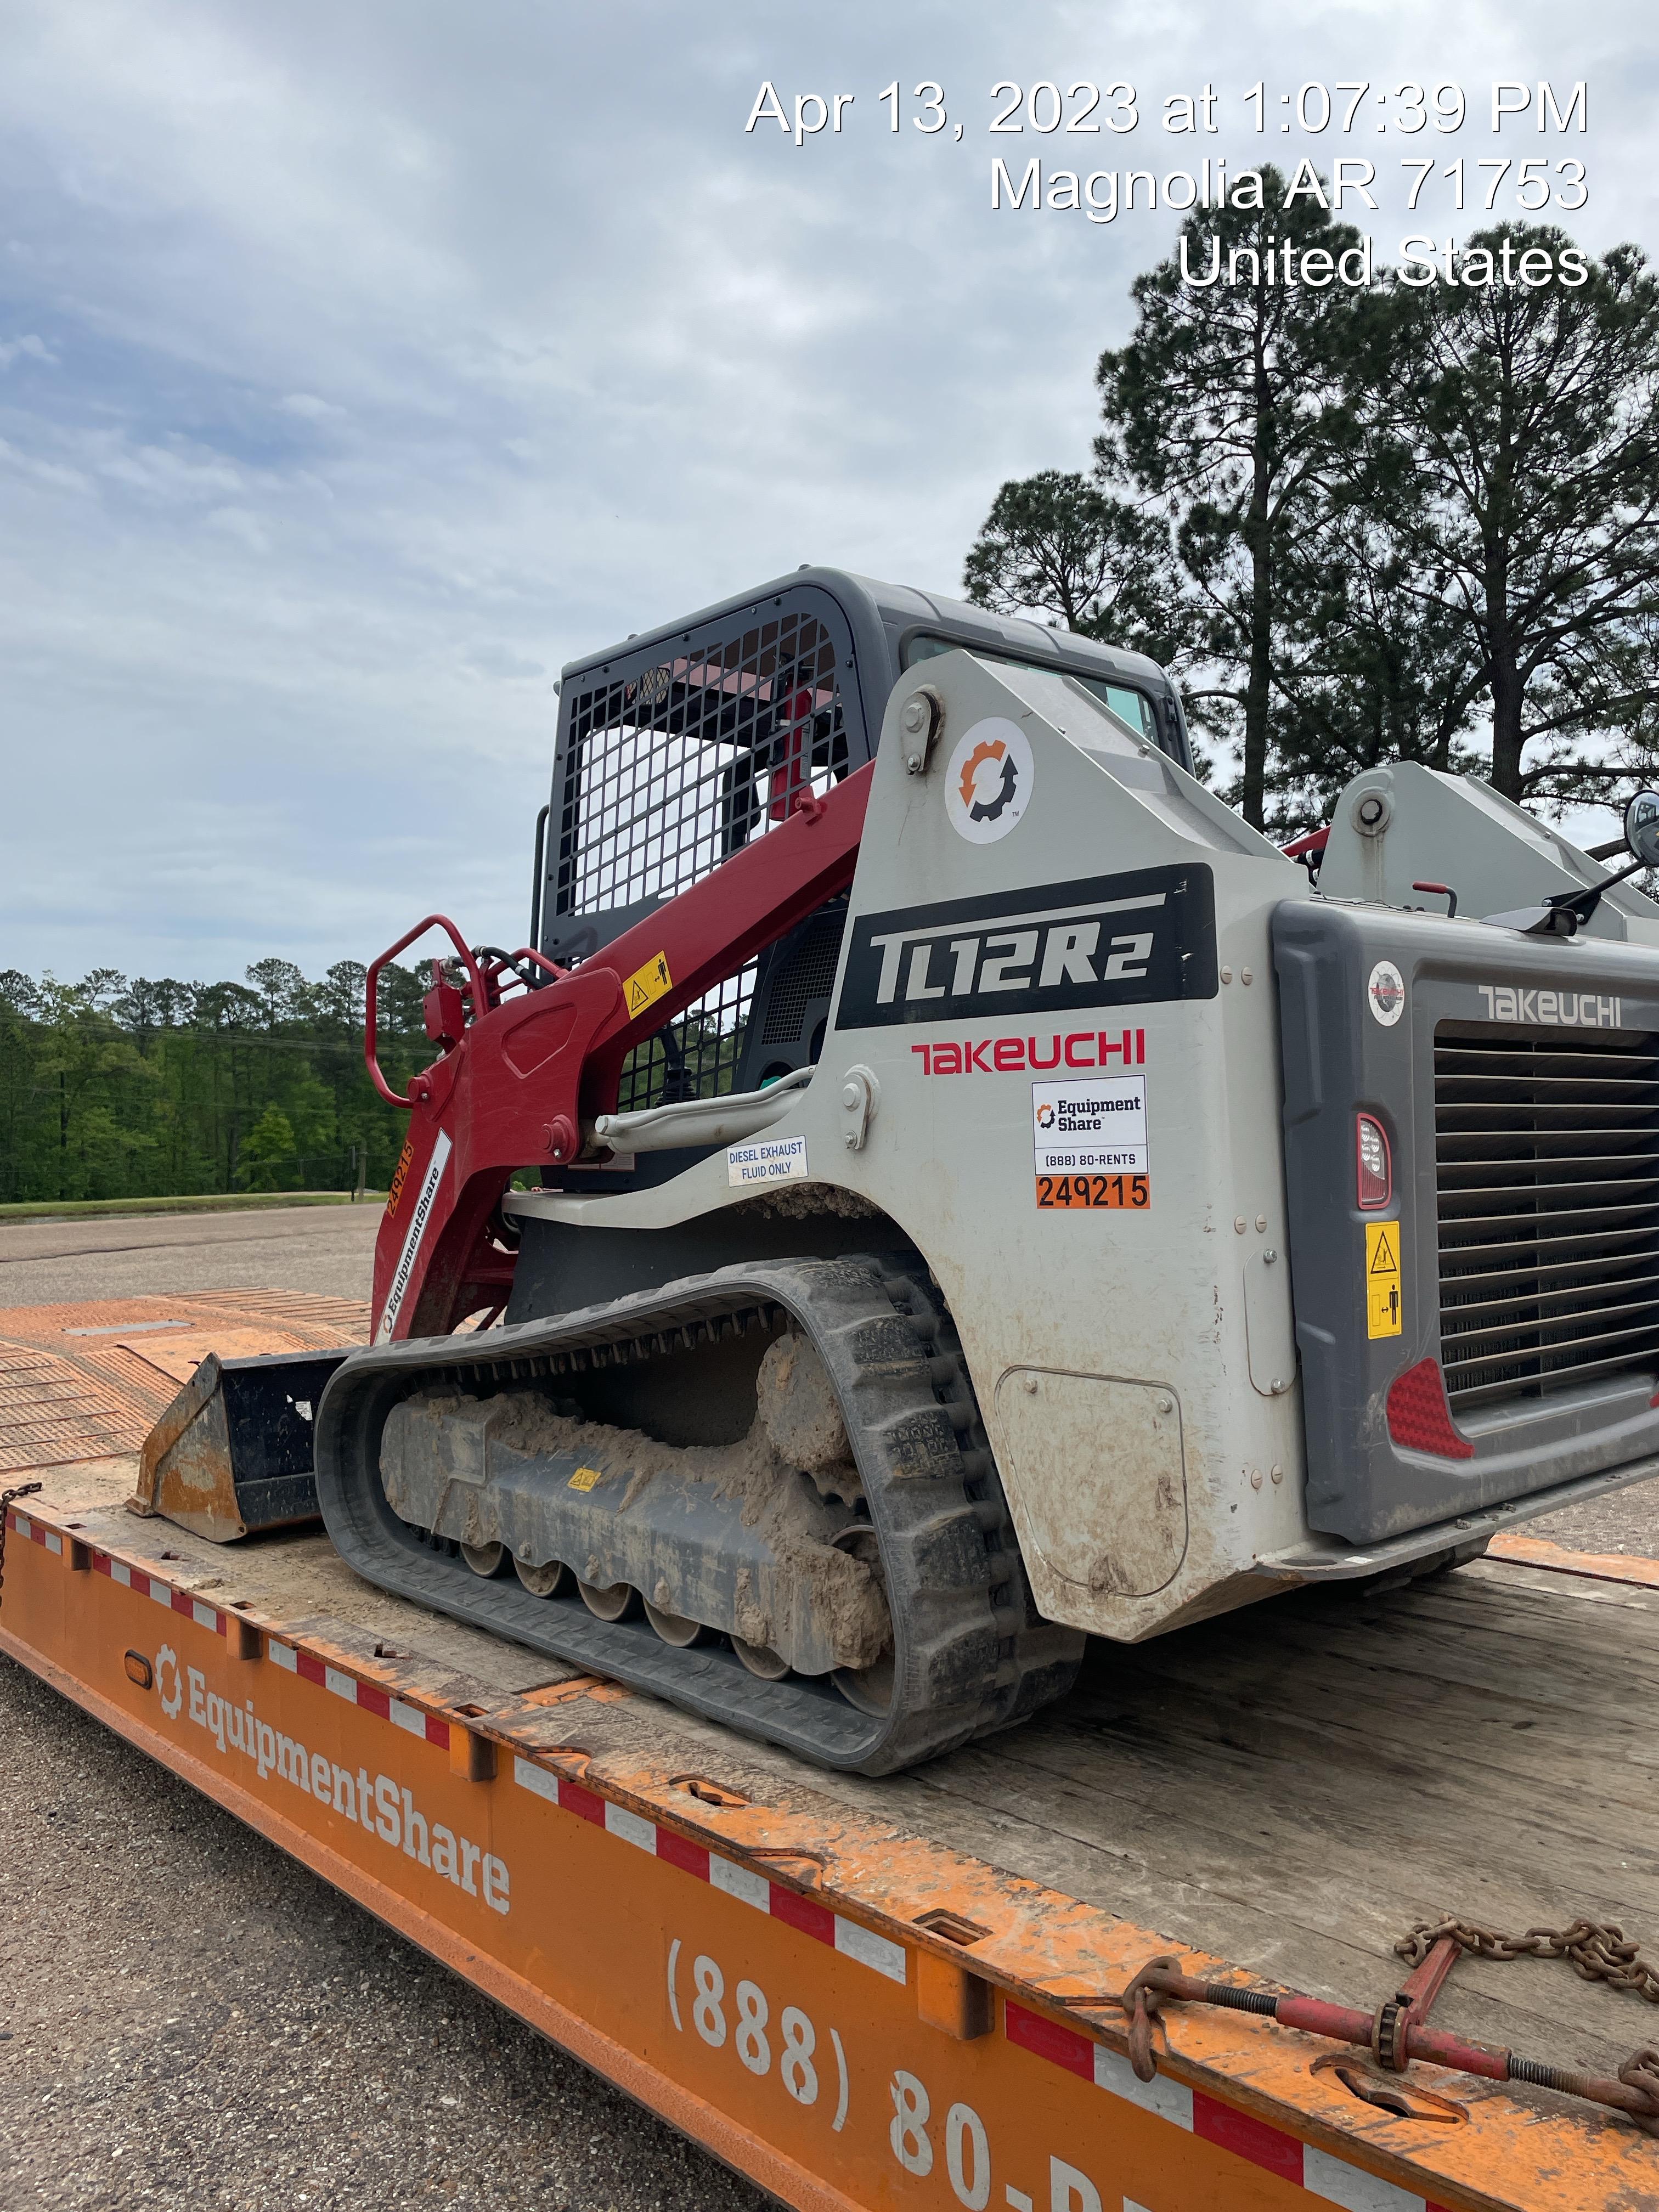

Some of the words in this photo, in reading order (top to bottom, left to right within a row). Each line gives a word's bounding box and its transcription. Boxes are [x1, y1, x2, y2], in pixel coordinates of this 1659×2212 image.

[1058, 1097, 1141, 1117] Equipment
[1058, 1117, 1102, 1131] Share
[730, 1149, 758, 1164] DIESEL
[761, 1142, 802, 1159] EXHAUST
[1046, 1154, 1076, 1166] (888)
[1080, 1154, 1136, 1166] 80-RENTS
[387, 1143, 413, 1215] 249215
[742, 1166, 766, 1180] FLUID
[769, 1162, 791, 1176] ONLY
[1039, 1175, 1148, 1206] 249215
[388, 1167, 439, 1315] EquipmentShare
[187, 1665, 510, 1916] EquipmentShare
[668, 1938, 849, 2132] (888)
